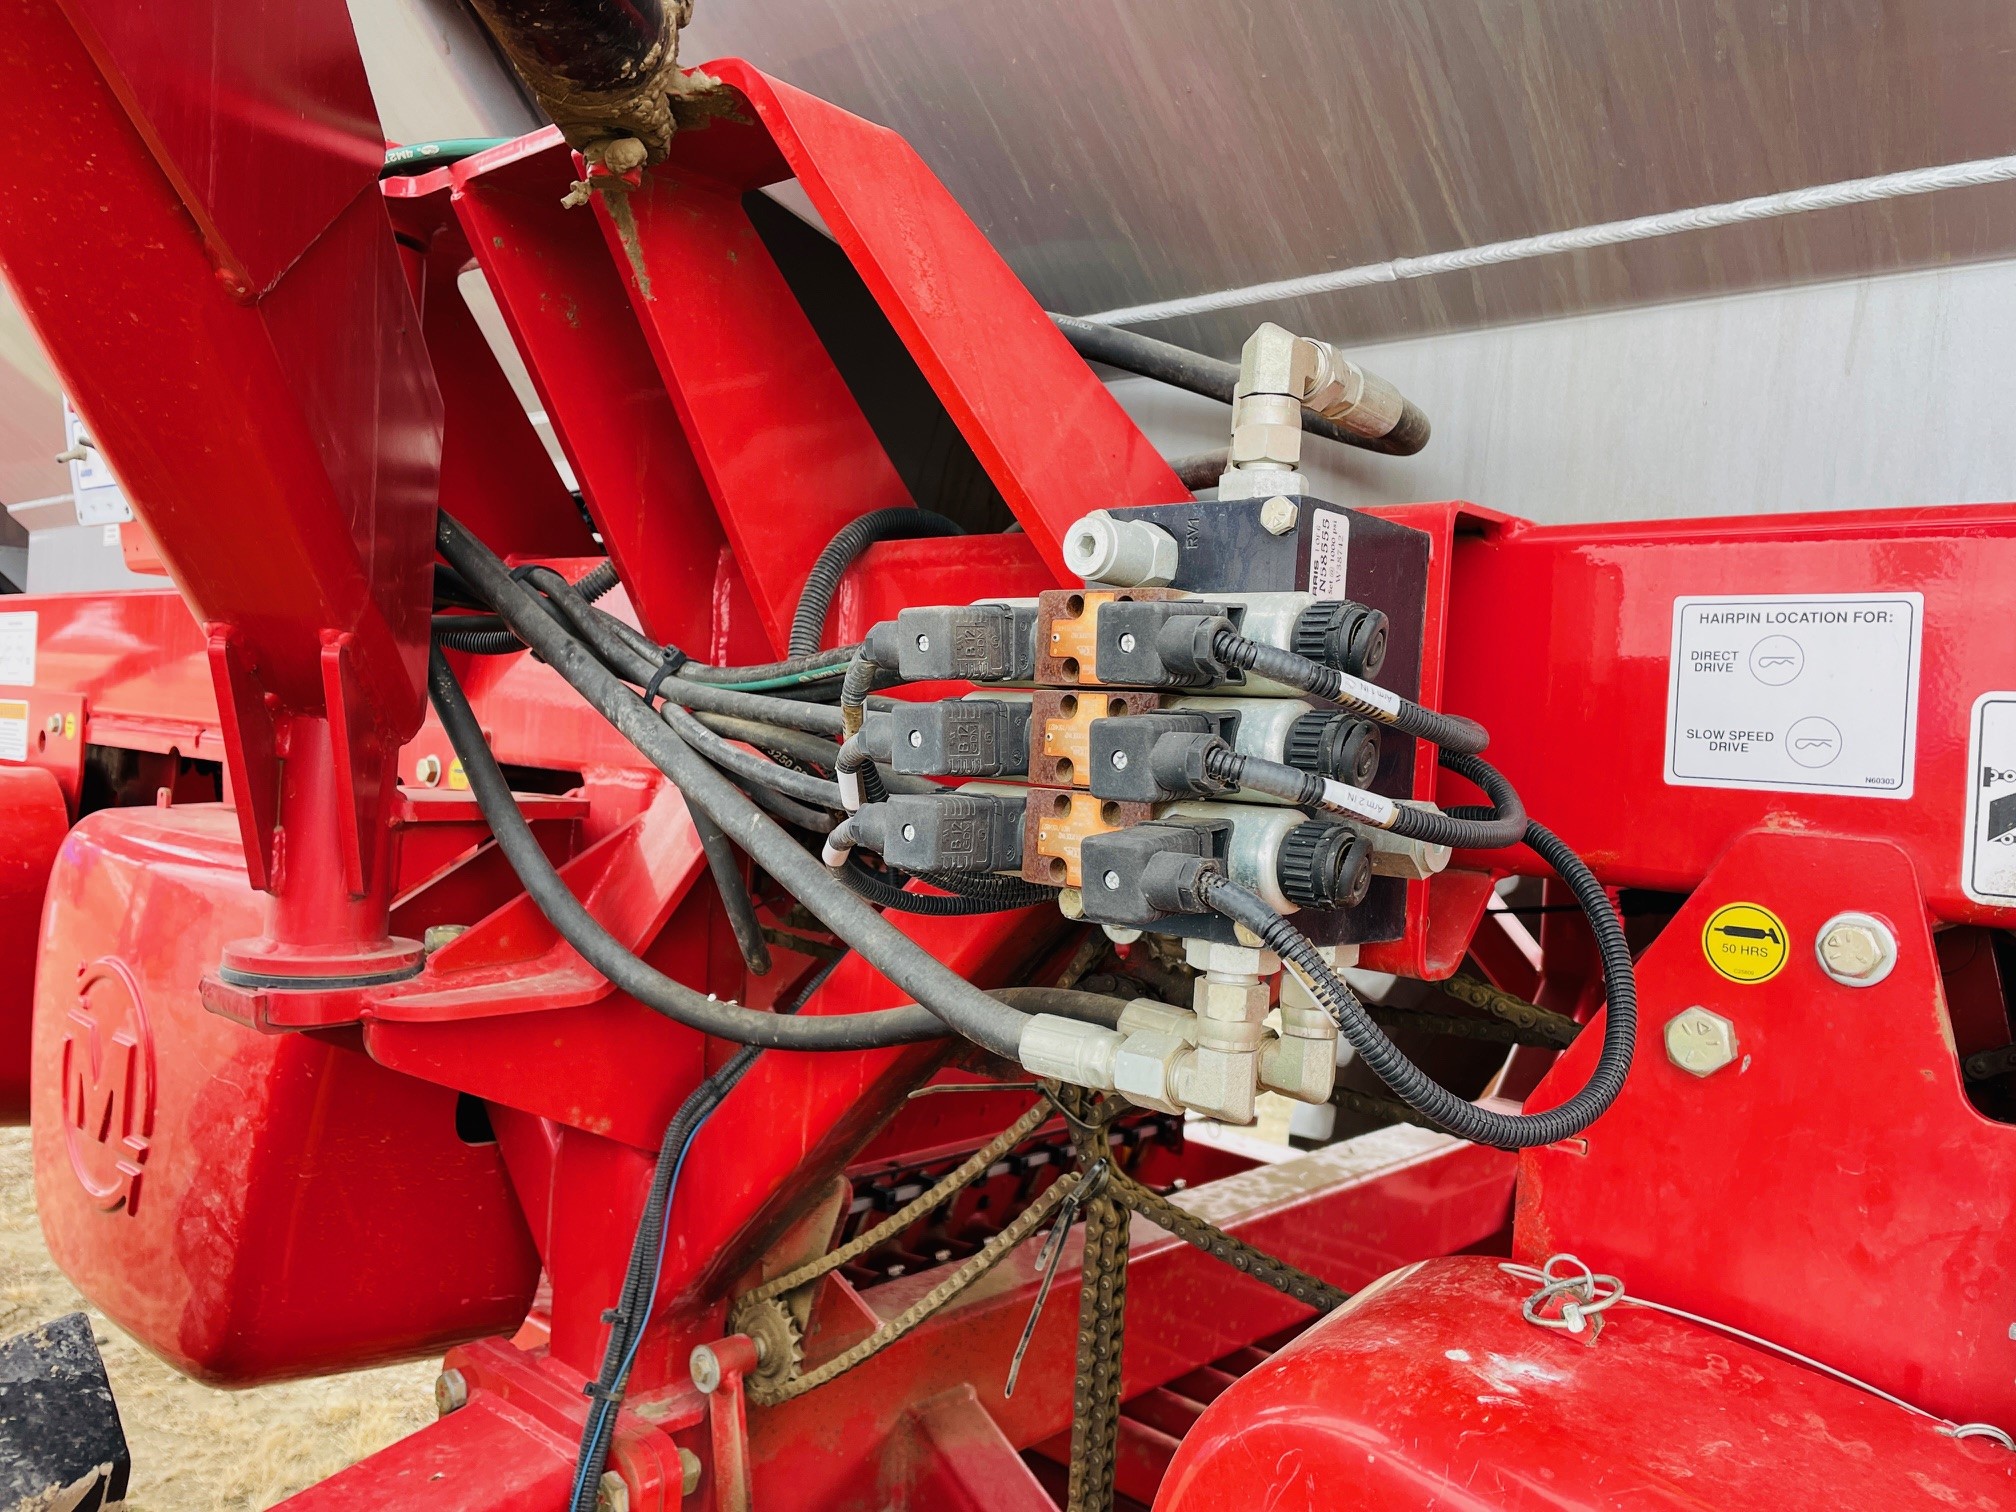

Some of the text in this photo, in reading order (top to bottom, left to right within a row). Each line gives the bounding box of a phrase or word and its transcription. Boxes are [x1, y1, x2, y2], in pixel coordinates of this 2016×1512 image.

[1186, 518, 1200, 550] RV1
[1319, 518, 1330, 593] N58555
[1699, 611, 1894, 624] HAIRPIN LOCATION FOR:
[1691, 650, 1739, 661] DIRECT
[1694, 662, 1734, 673] DRIVE
[1686, 729, 1774, 742] SLOW SPEED
[1709, 741, 1749, 753] DRIVE
[1347, 792, 1384, 813] Arm 2 IN
[1722, 943, 1768, 958] 50 HRS
